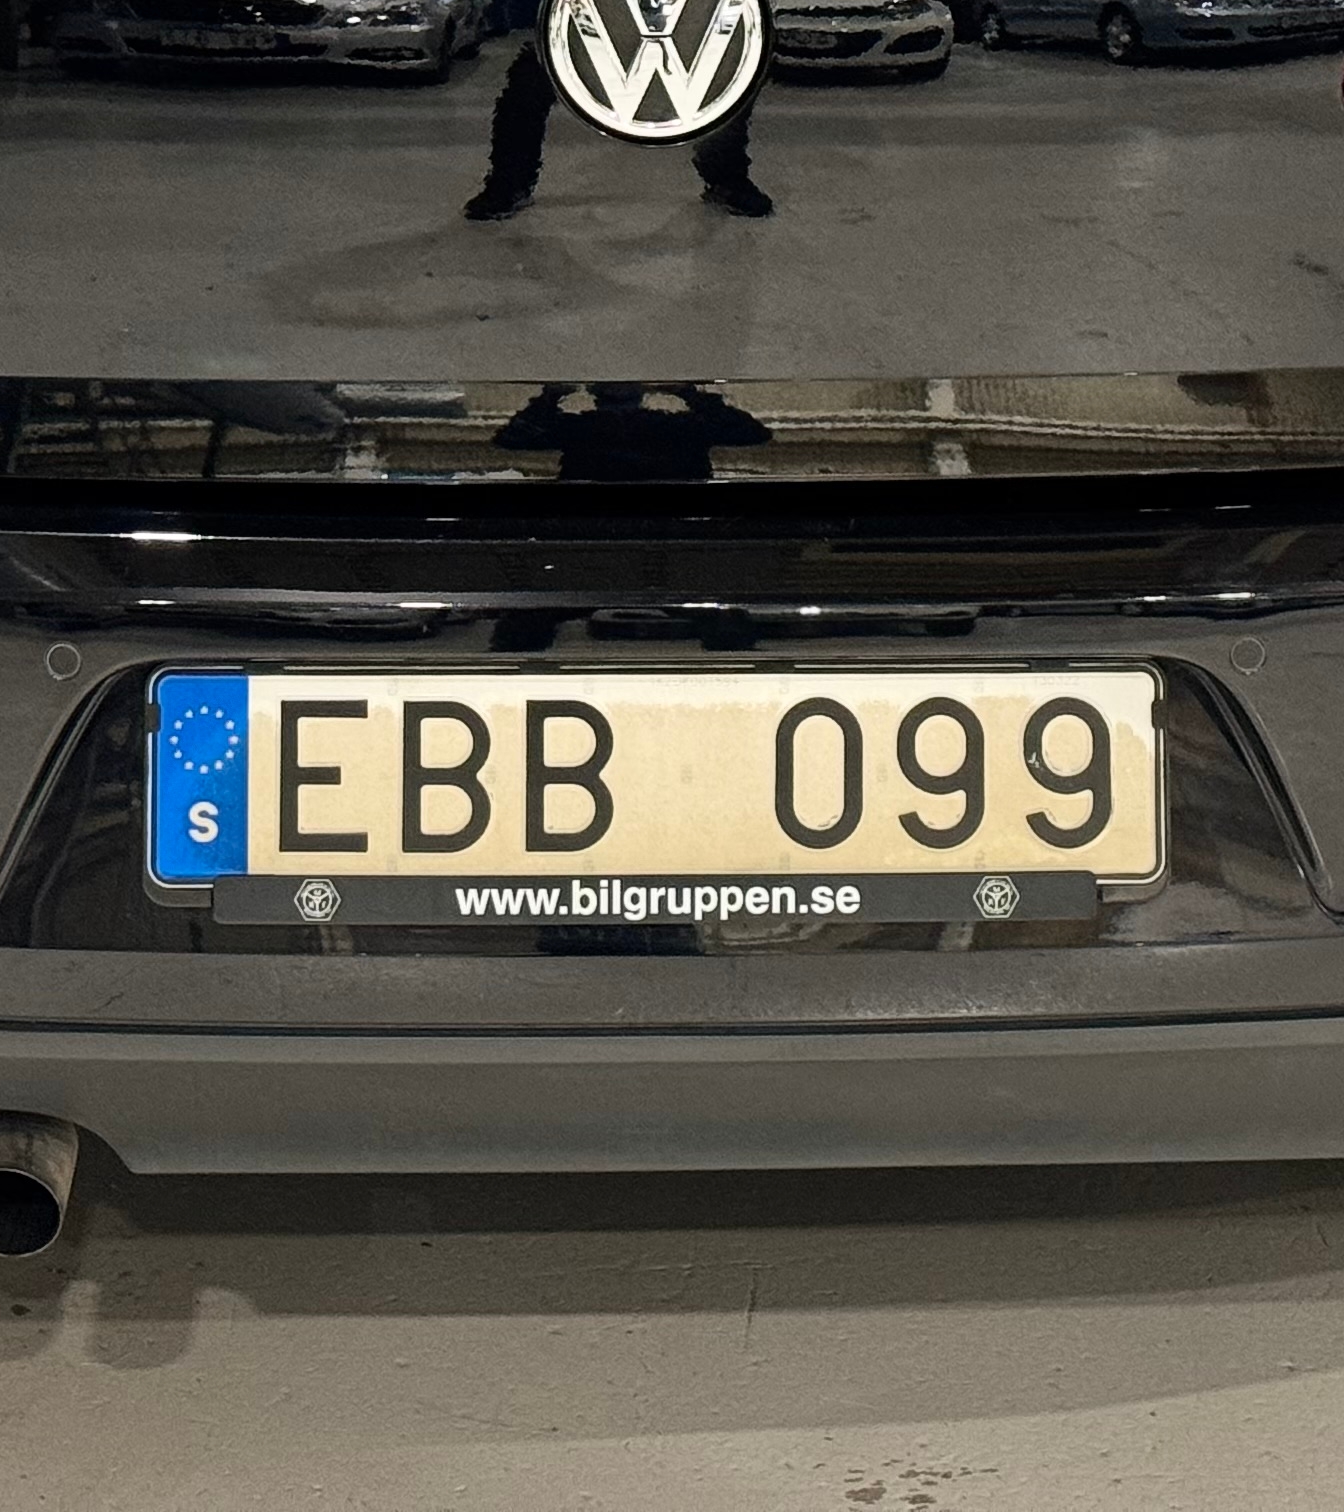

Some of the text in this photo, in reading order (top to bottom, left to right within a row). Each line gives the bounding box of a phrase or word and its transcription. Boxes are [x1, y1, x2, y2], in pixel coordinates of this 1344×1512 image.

[279, 696, 1112, 853] EBB 099
[188, 801, 219, 843] S
[456, 879, 862, 922] www.bilgruppen.se
